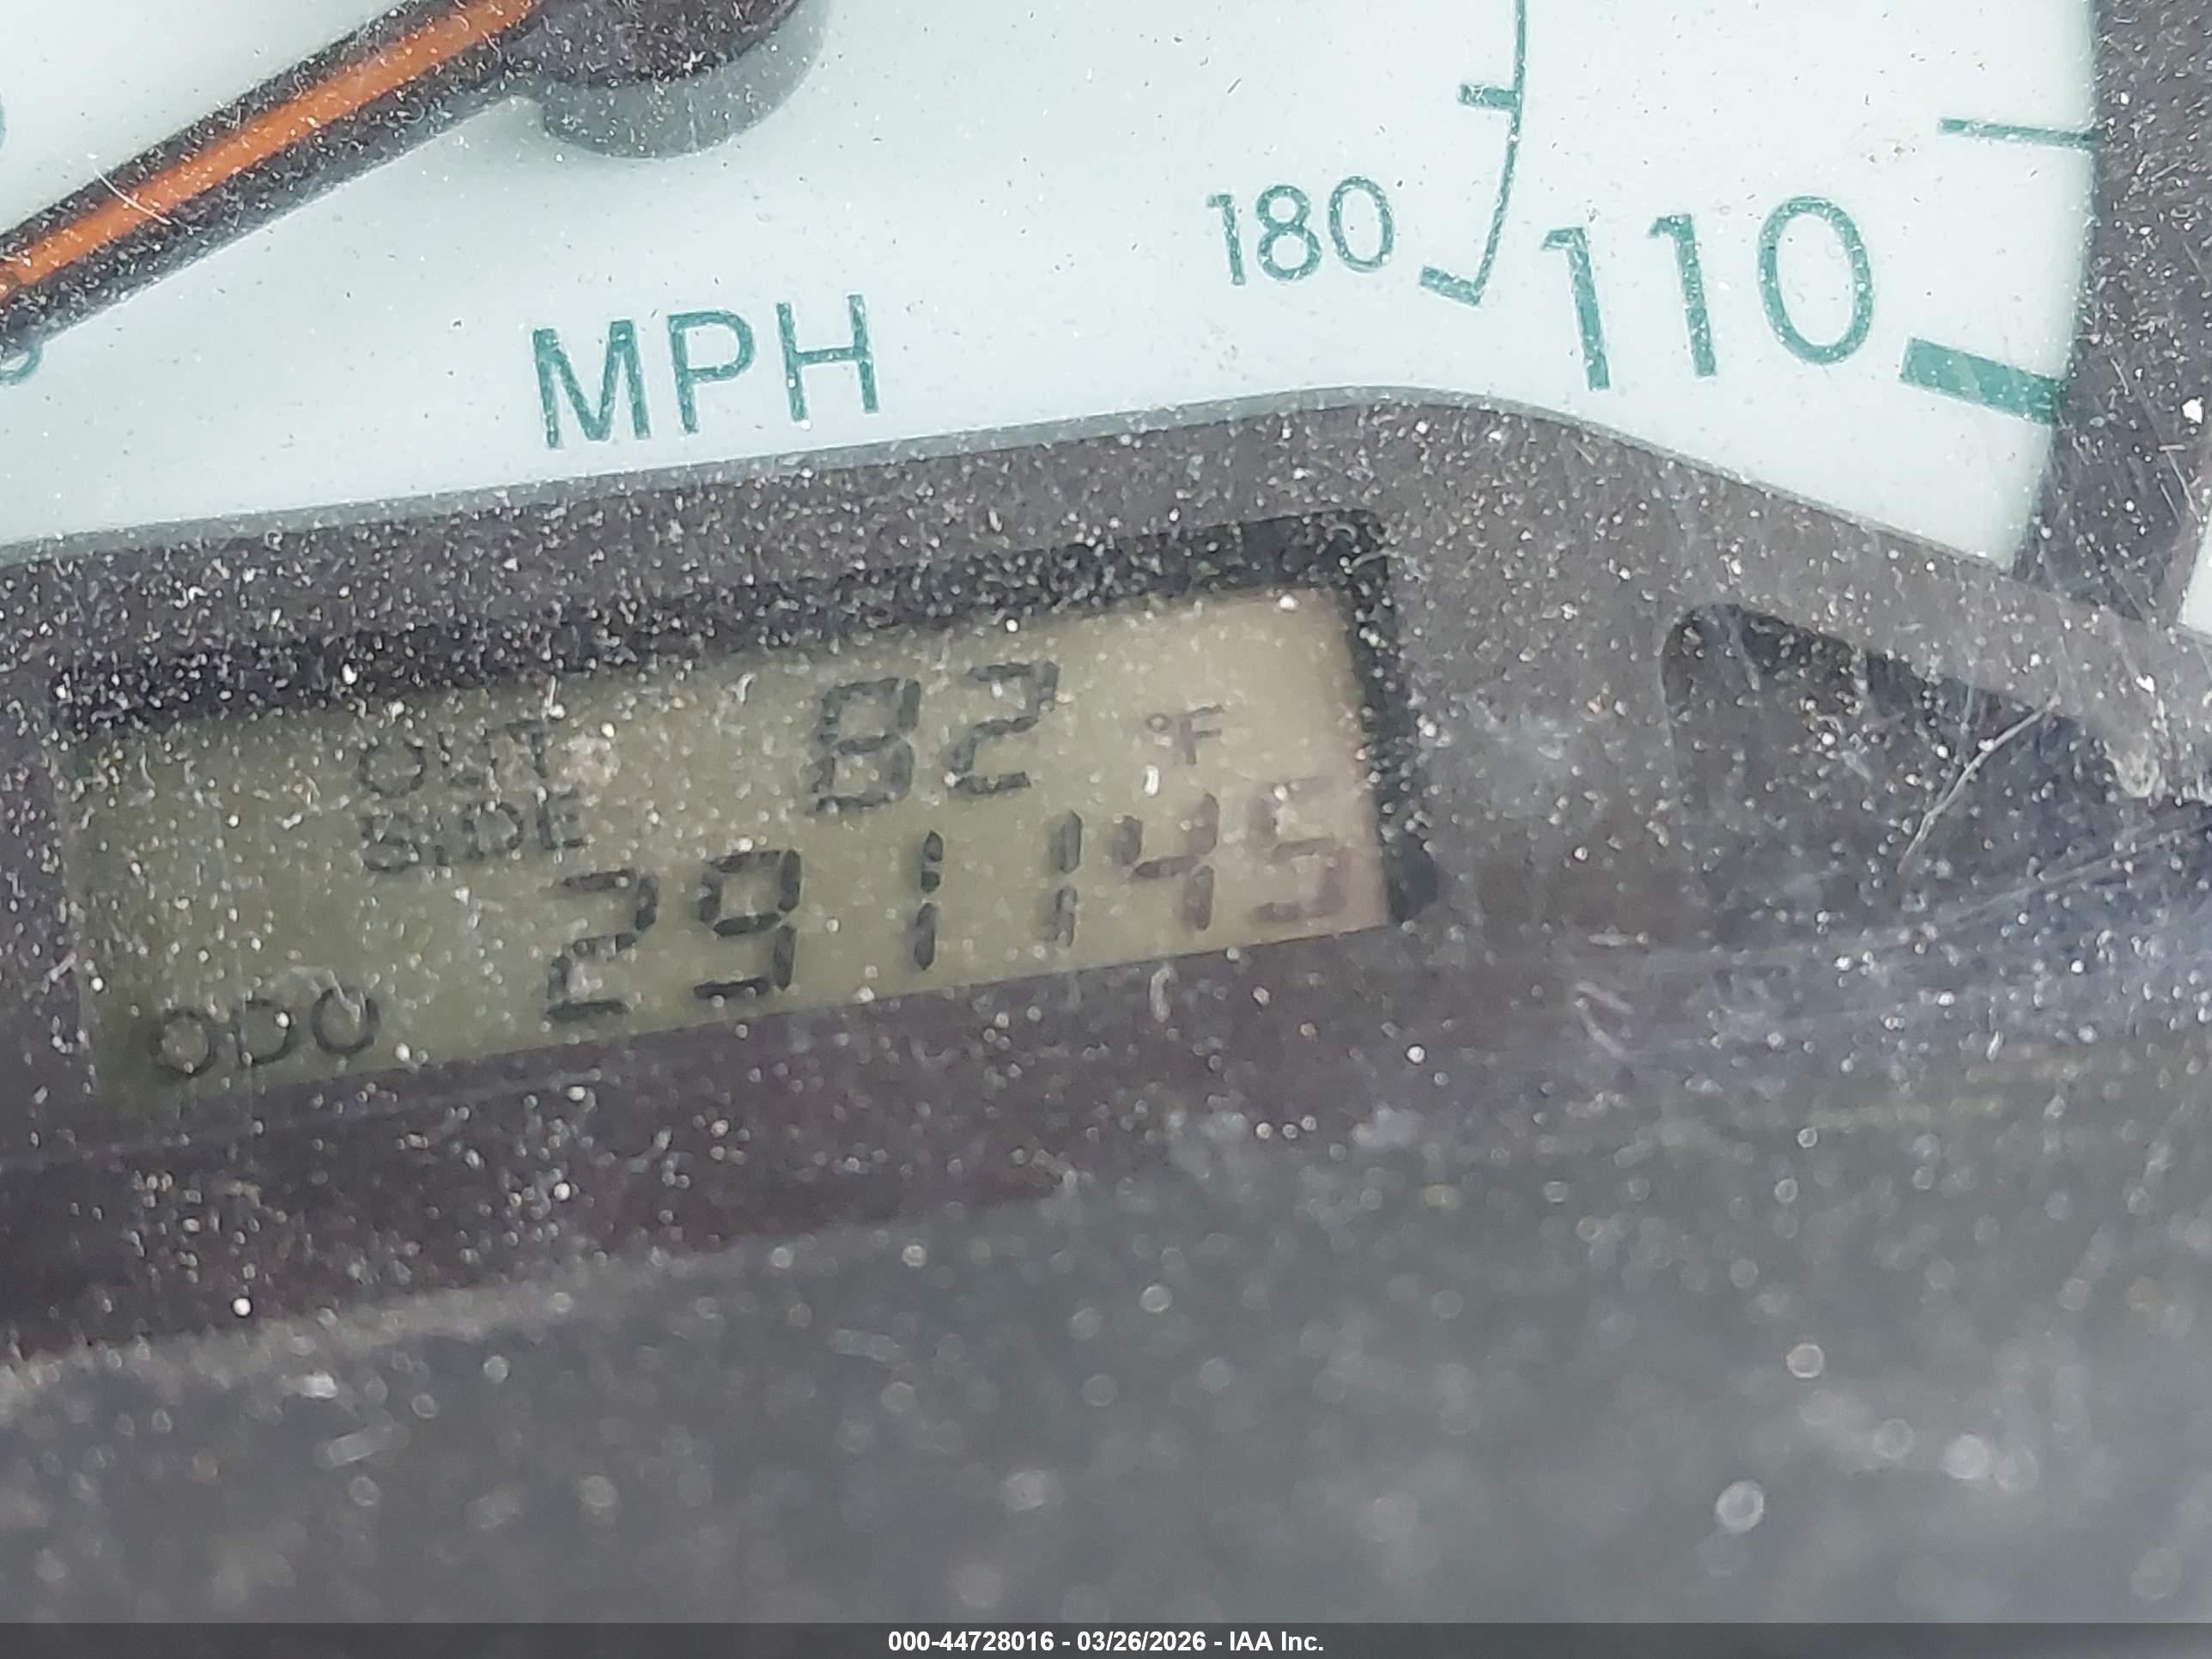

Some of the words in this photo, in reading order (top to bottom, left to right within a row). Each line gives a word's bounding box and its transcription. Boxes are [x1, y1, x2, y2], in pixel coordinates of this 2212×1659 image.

[1206, 176, 1395, 286] 180
[1541, 195, 1875, 391] 110
[532, 293, 879, 450] MPH
[810, 660, 1060, 816] 82
[157, 984, 381, 1078] ODO
[544, 775, 1350, 1022] 291145
